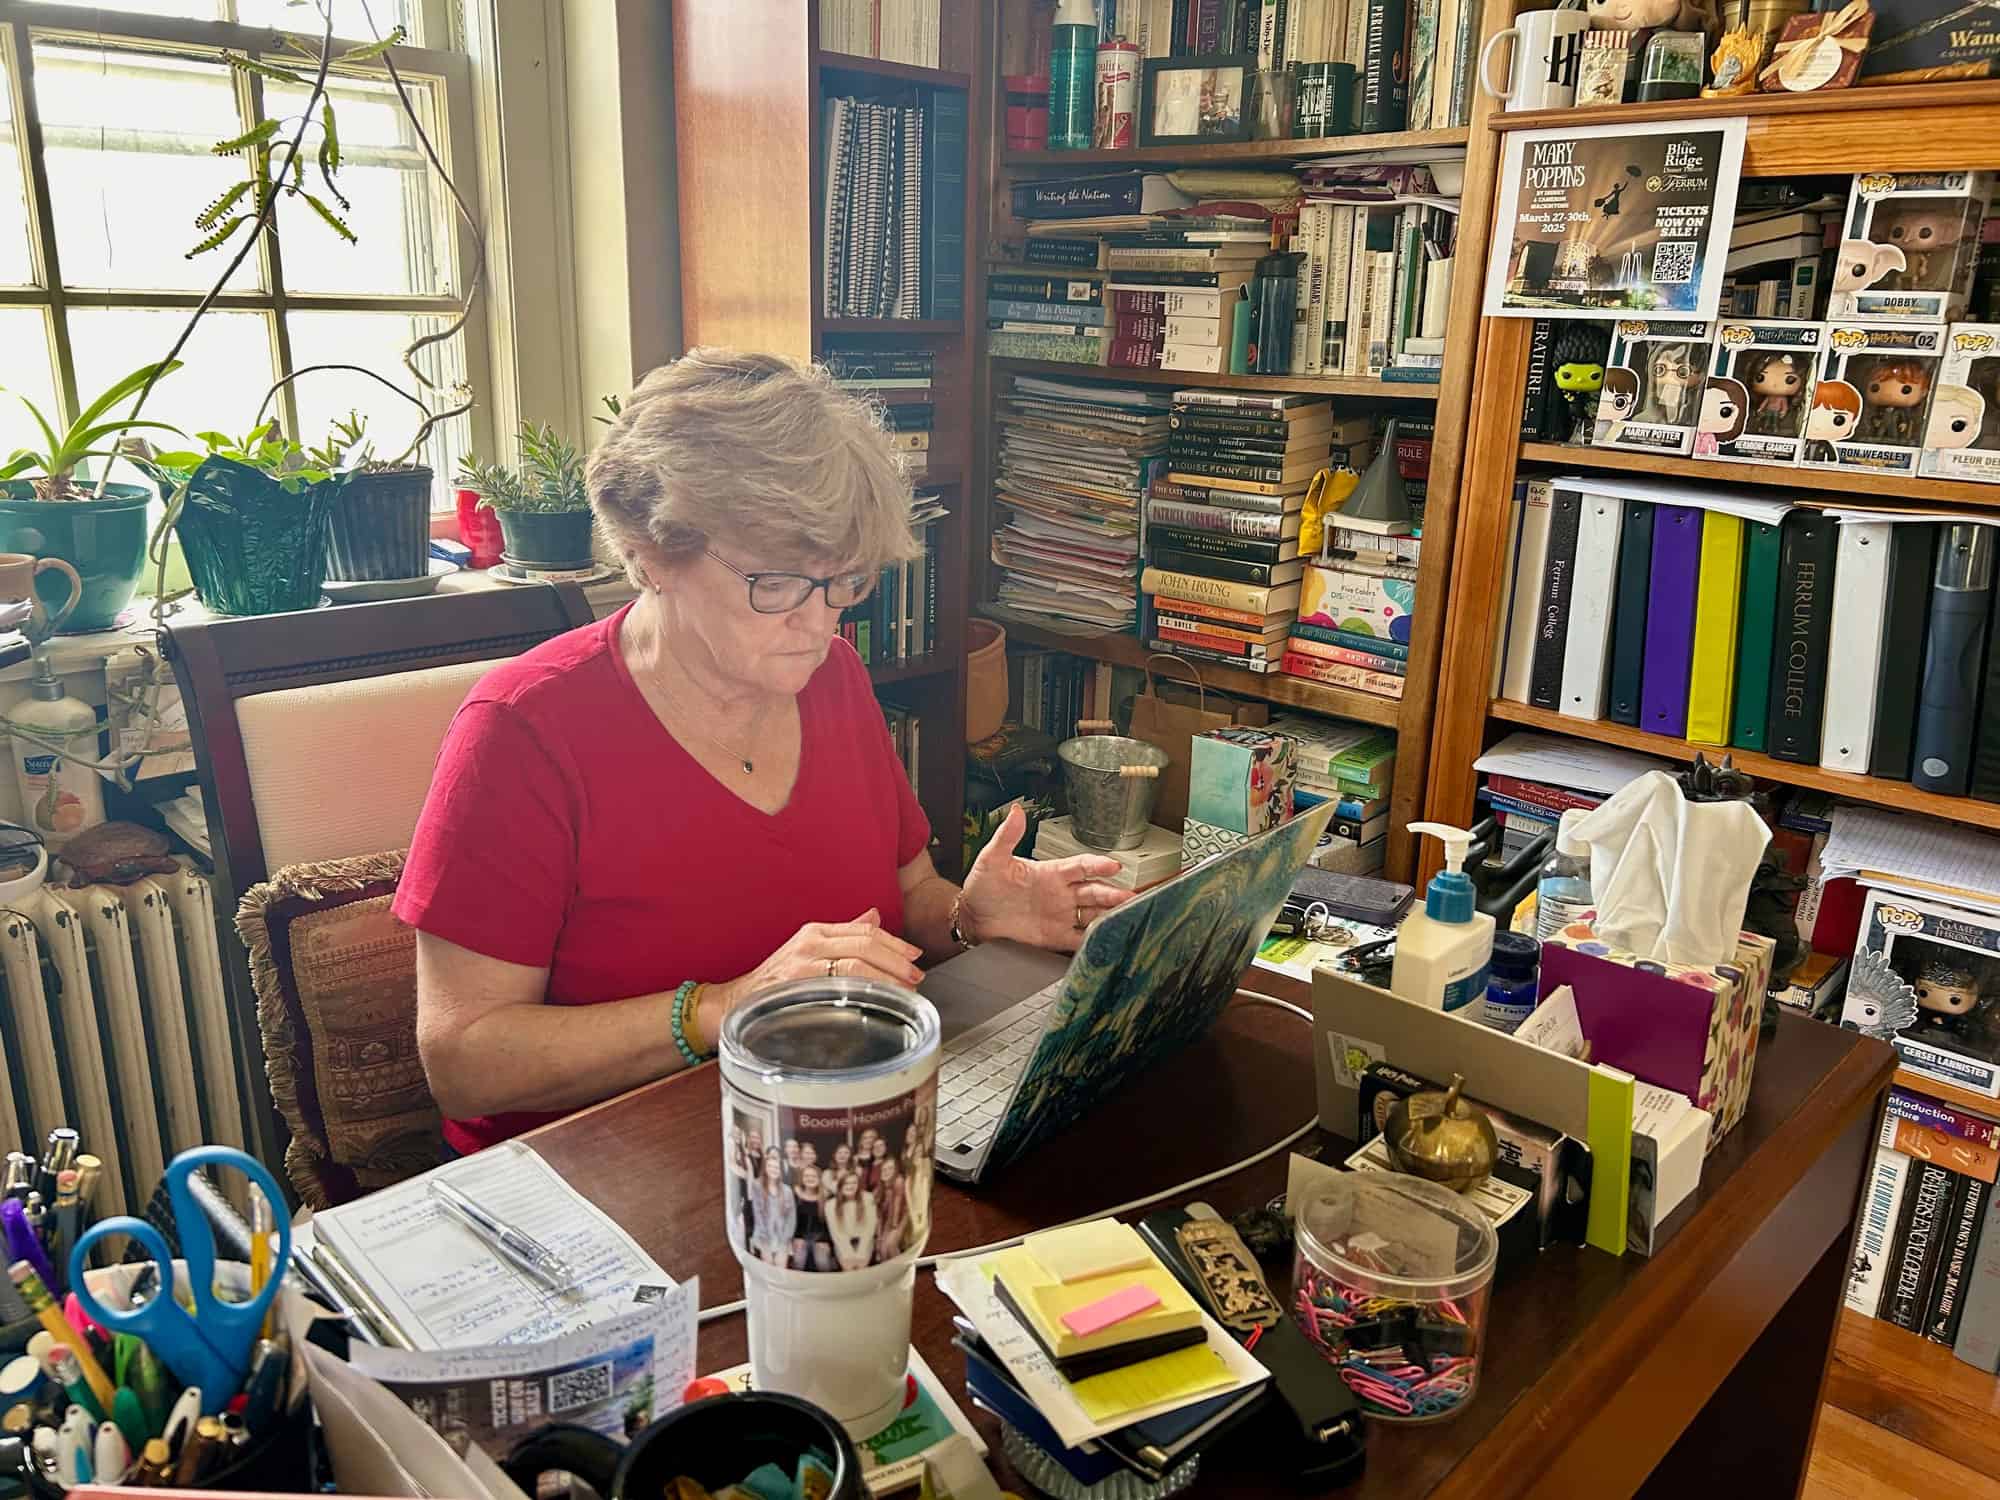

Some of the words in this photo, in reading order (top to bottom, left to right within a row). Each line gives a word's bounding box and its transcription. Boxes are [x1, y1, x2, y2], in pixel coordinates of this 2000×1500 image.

[1369, 5, 1385, 56] PERCIVAL
[1366, 59, 1381, 105] EVERETT
[1532, 142, 1576, 166] MARY
[1667, 143, 1697, 155] Blue
[1664, 154, 1704, 169] Ridge
[1524, 165, 1585, 189] POPPINS
[1660, 174, 1708, 192] FERRUM
[1947, 175, 1963, 187] 17
[1035, 189, 1067, 204] Writing
[1068, 189, 1080, 200] the
[1081, 189, 1112, 200] Nation
[1519, 212, 1550, 223] March
[1552, 210, 1592, 223] 27-30th,
[1656, 205, 1710, 216] TICKETS
[1540, 224, 1566, 233] 2025
[1656, 216, 1685, 228] NOW
[1686, 216, 1704, 227] ON
[1884, 297, 1920, 307] DOBBY
[1689, 324, 1704, 335] 42
[1722, 326, 1754, 345] POP!
[1800, 330, 1817, 343] 43
[1832, 330, 1869, 348] POP!
[1918, 335, 1934, 347] 02
[1953, 334, 1994, 353] POP!
[1624, 426, 1650, 438] HARRY
[1651, 429, 1681, 441] POTTER
[1218, 438, 1247, 449] Saturday
[1398, 447, 1423, 458] RULE
[1840, 448, 1861, 458] RON
[1862, 449, 1907, 462] WEASLEY
[1952, 454, 1983, 465] FLEUR
[1175, 462, 1208, 472] LOUISE
[1210, 464, 1241, 476] PENNY
[1160, 573, 1188, 589] JOHN
[1192, 578, 1231, 598] IRVING
[1551, 560, 1565, 598] Ferrum
[1792, 561, 1815, 635] FERRUM
[1543, 605, 1559, 639] College
[1367, 657, 1386, 667] WEIR
[1785, 640, 1807, 720] COLLEGE
[1879, 906, 1923, 929] POP!
[1939, 918, 1973, 935] GAME
[1935, 926, 1985, 947] THRONES
[1902, 1046, 1937, 1064] CERSEI
[1938, 1053, 1989, 1080] LANNISTER
[799, 1113, 848, 1128] Boone
[854, 1106, 900, 1125] Honors
[1887, 1096, 1955, 1124] ntroduction
[1966, 1180, 1982, 1217] STEPHEN
[1897, 1217, 1931, 1298] ENCYCLOPEDIA
